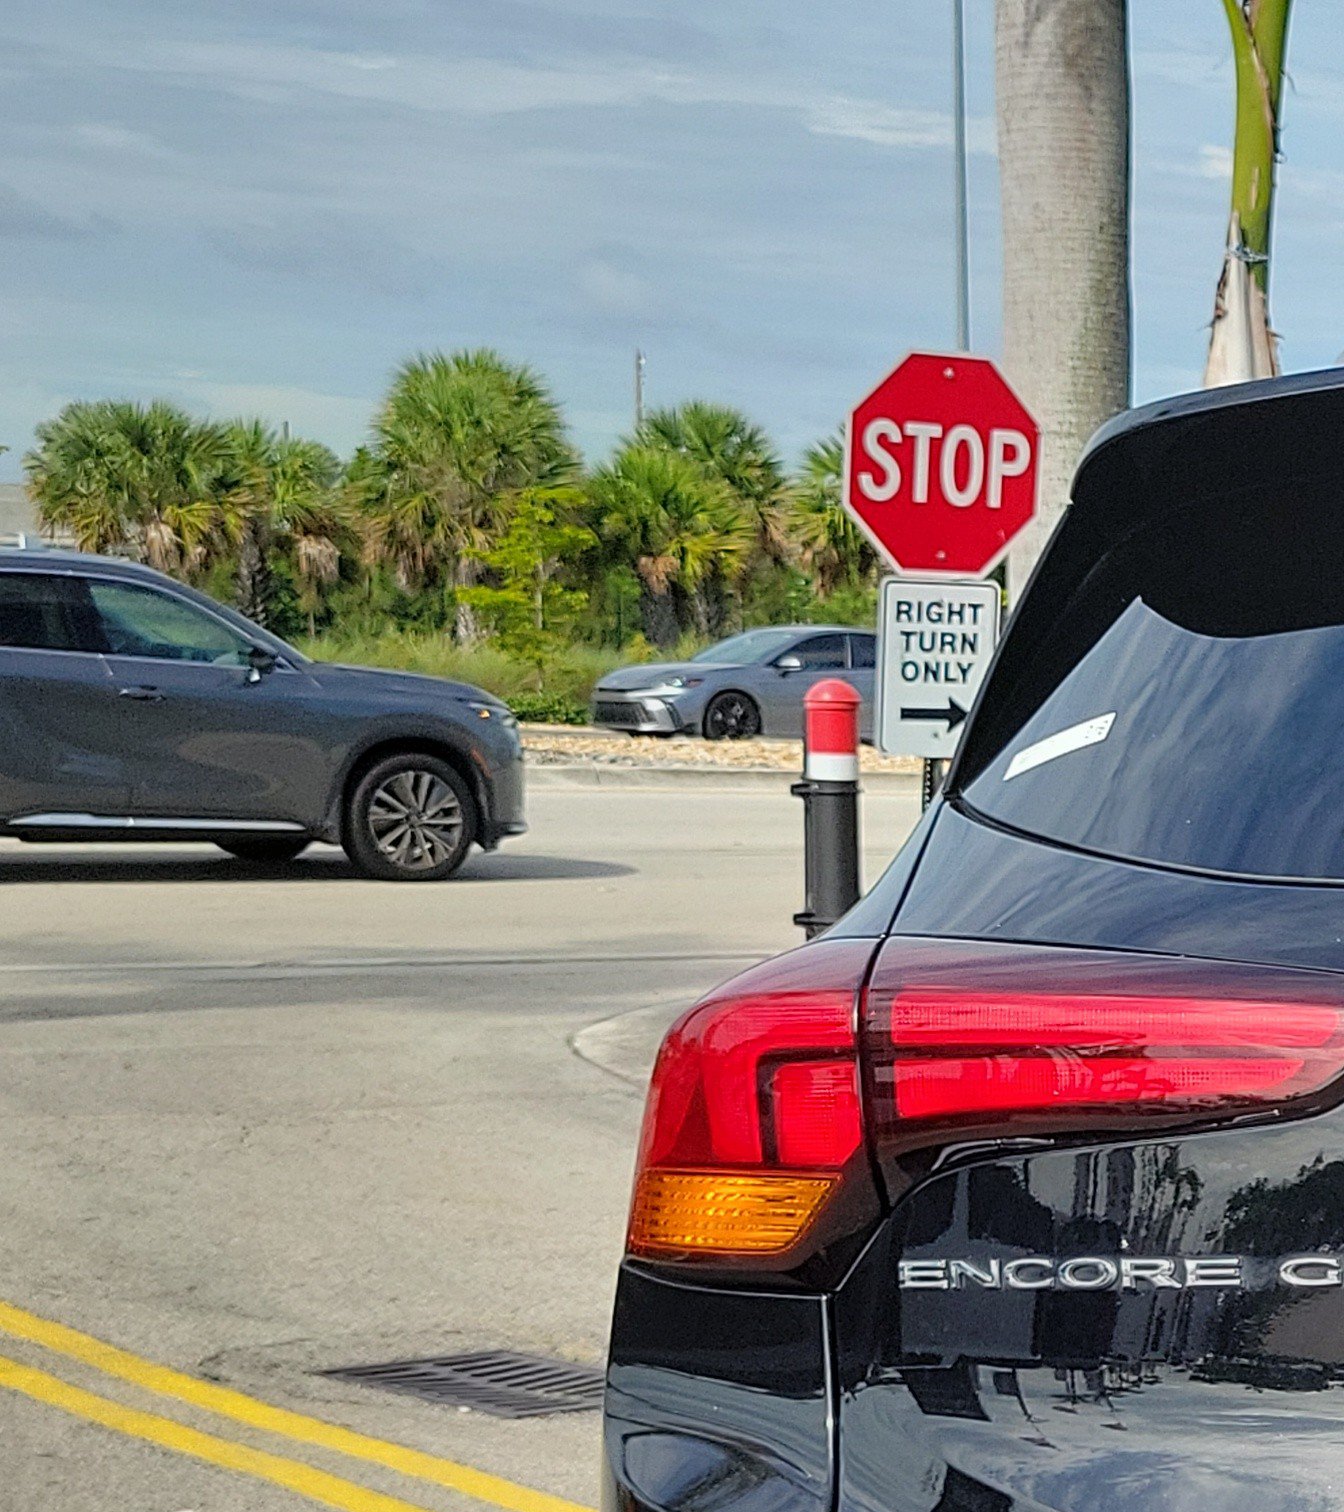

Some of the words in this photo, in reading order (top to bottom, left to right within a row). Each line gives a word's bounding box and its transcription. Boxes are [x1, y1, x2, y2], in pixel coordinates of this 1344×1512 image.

[857, 416, 1031, 509] STOP
[895, 600, 985, 626] RIGHT
[900, 630, 979, 655] TURN
[900, 659, 975, 684] ONLY
[898, 1257, 1243, 1290] ENCORE
